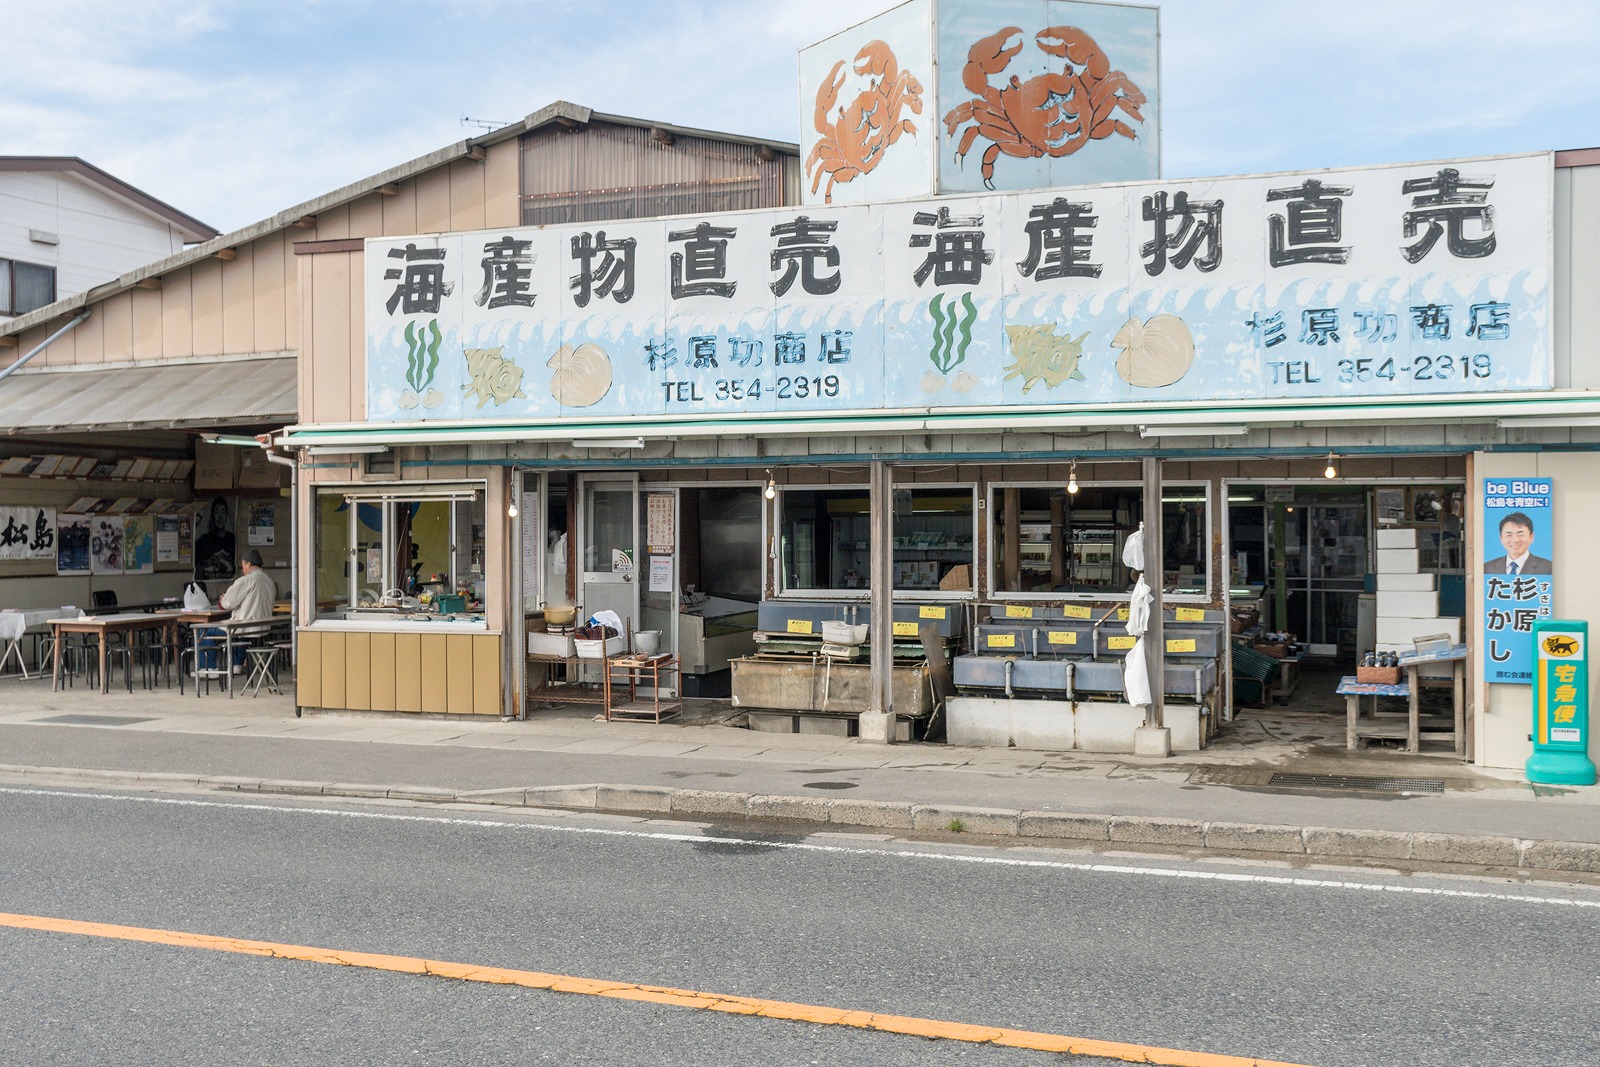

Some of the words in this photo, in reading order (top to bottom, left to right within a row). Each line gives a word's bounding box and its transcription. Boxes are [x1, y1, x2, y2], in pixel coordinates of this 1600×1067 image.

[908, 167, 1497, 288] 海産物直売
[384, 215, 841, 316] 海産物直売
[1244, 301, 1511, 349] 杉原功商店
[643, 329, 853, 372] 杉原功商店
[1267, 359, 1322, 385] TEL
[1337, 353, 1491, 383] 354-2319
[662, 382, 703, 403] TEL
[715, 375, 840, 401] 354-2319
[1486, 480, 1508, 495] be
[1512, 480, 1549, 495] Blue
[1486, 497, 1549, 508] 松島を青空に!
[1, 509, 54, 551] 松島
[1487, 577, 1511, 663] たかし
[1512, 577, 1538, 632] 杉原
[1540, 582, 1550, 620] すぎは
[1553, 664, 1578, 723] 宅急便
